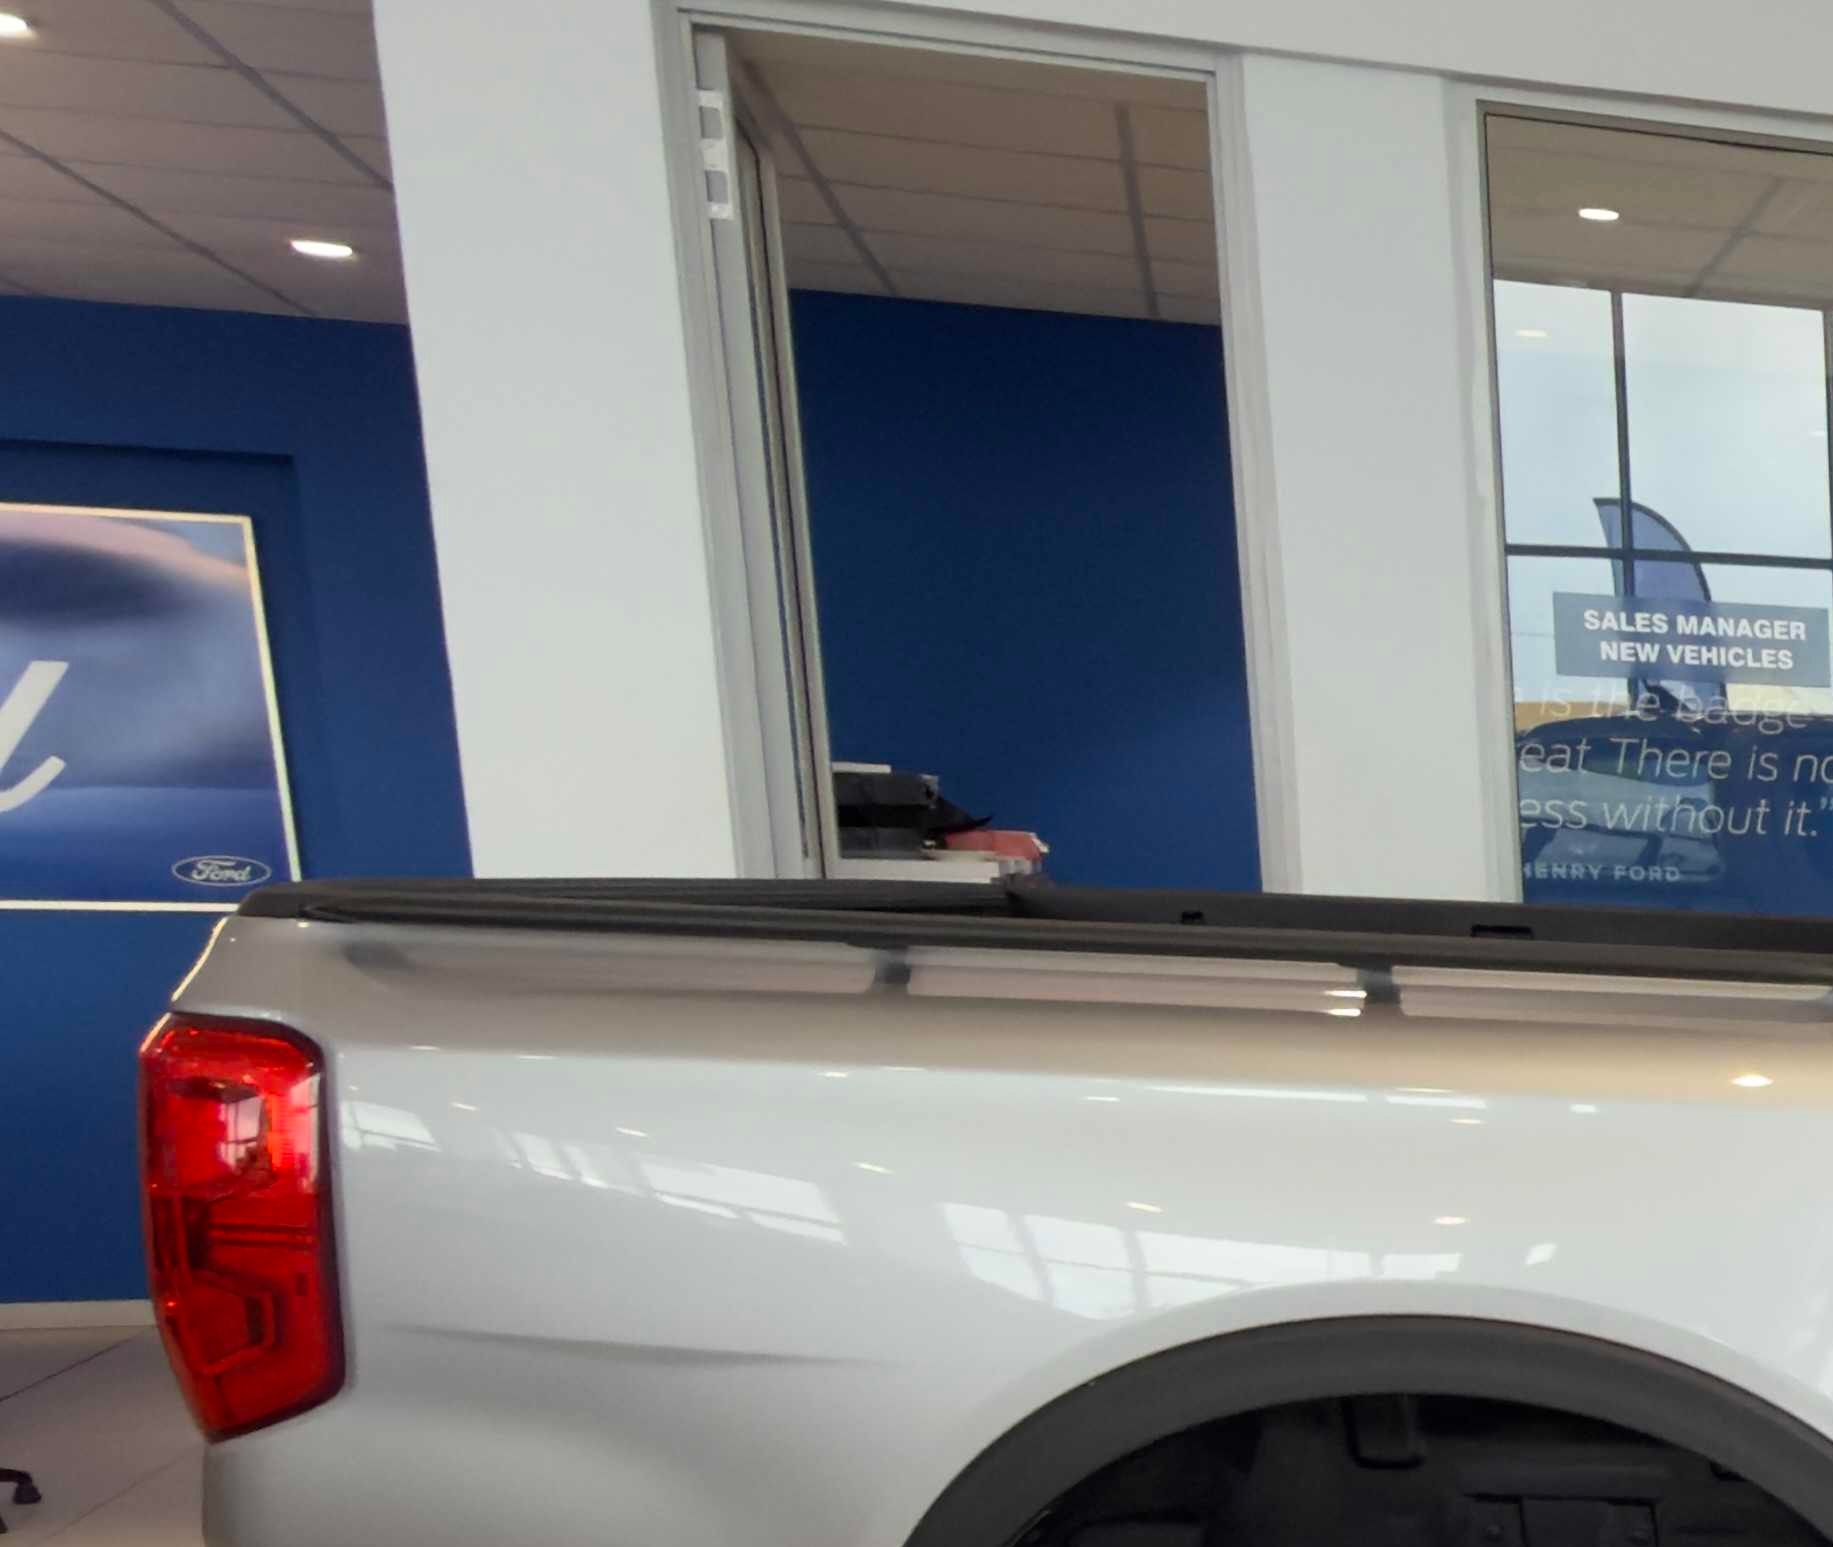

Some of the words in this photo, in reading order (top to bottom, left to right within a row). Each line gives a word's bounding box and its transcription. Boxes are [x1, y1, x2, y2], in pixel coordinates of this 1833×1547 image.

[1583, 609, 1669, 635] SALES
[1676, 614, 1807, 642] MANAGER
[1600, 641, 1660, 664] NEW
[1666, 643, 1794, 671] VEHICLES
[1519, 736, 1593, 776] eat
[1608, 737, 1733, 780] There
[1747, 744, 1779, 783] is
[1519, 798, 1589, 831] ess
[1603, 797, 1772, 836] without
[189, 859, 254, 884] Ford
[1613, 864, 1682, 882] FORD
